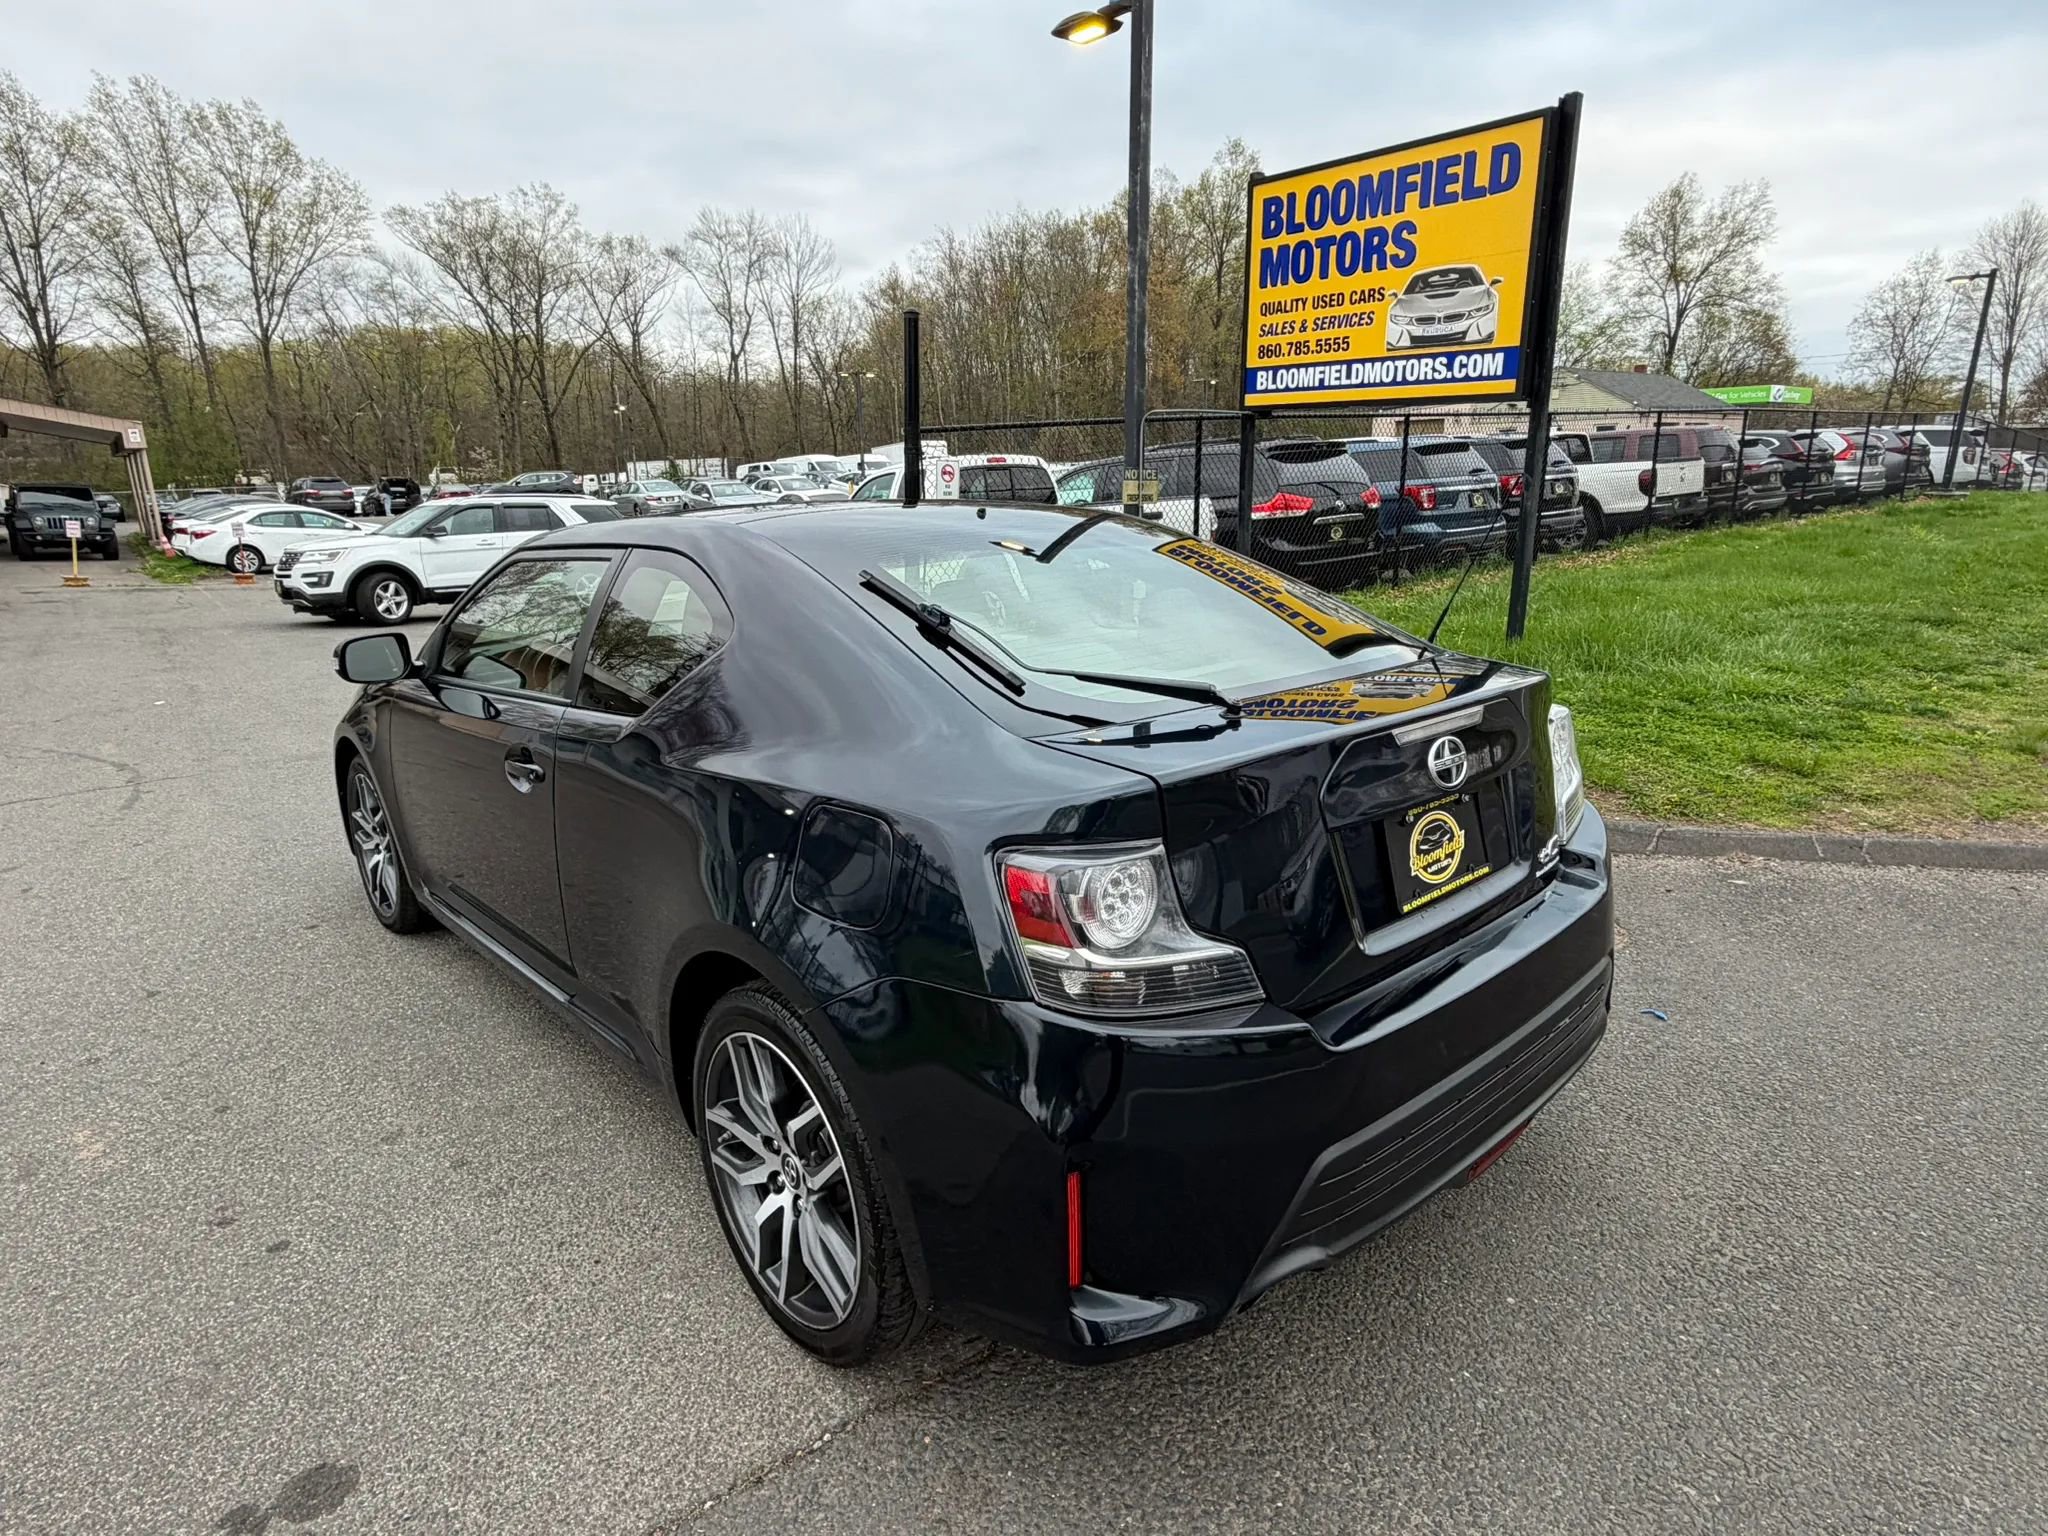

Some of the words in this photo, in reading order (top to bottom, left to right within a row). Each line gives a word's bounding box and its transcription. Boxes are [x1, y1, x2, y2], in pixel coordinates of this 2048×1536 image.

[1261, 141, 1521, 240] BLOOMFIELD
[1259, 220, 1418, 289] MOTORS
[1260, 297, 1308, 317] QUALITY
[1312, 292, 1345, 310] USED
[1349, 287, 1386, 306] CARS
[1259, 320, 1296, 338] SALES
[1298, 319, 1309, 333] &
[1312, 311, 1375, 332] SERVICES
[1257, 336, 1350, 360] 860.785.5555
[1256, 353, 1504, 391] BLOOMFIELDMOTORS.COM
[1124, 469, 1157, 480] NOICE
[1413, 838, 1463, 871] Bloomfield
[1402, 866, 1490, 913] BLOOMFIELDMOTORS.COM
